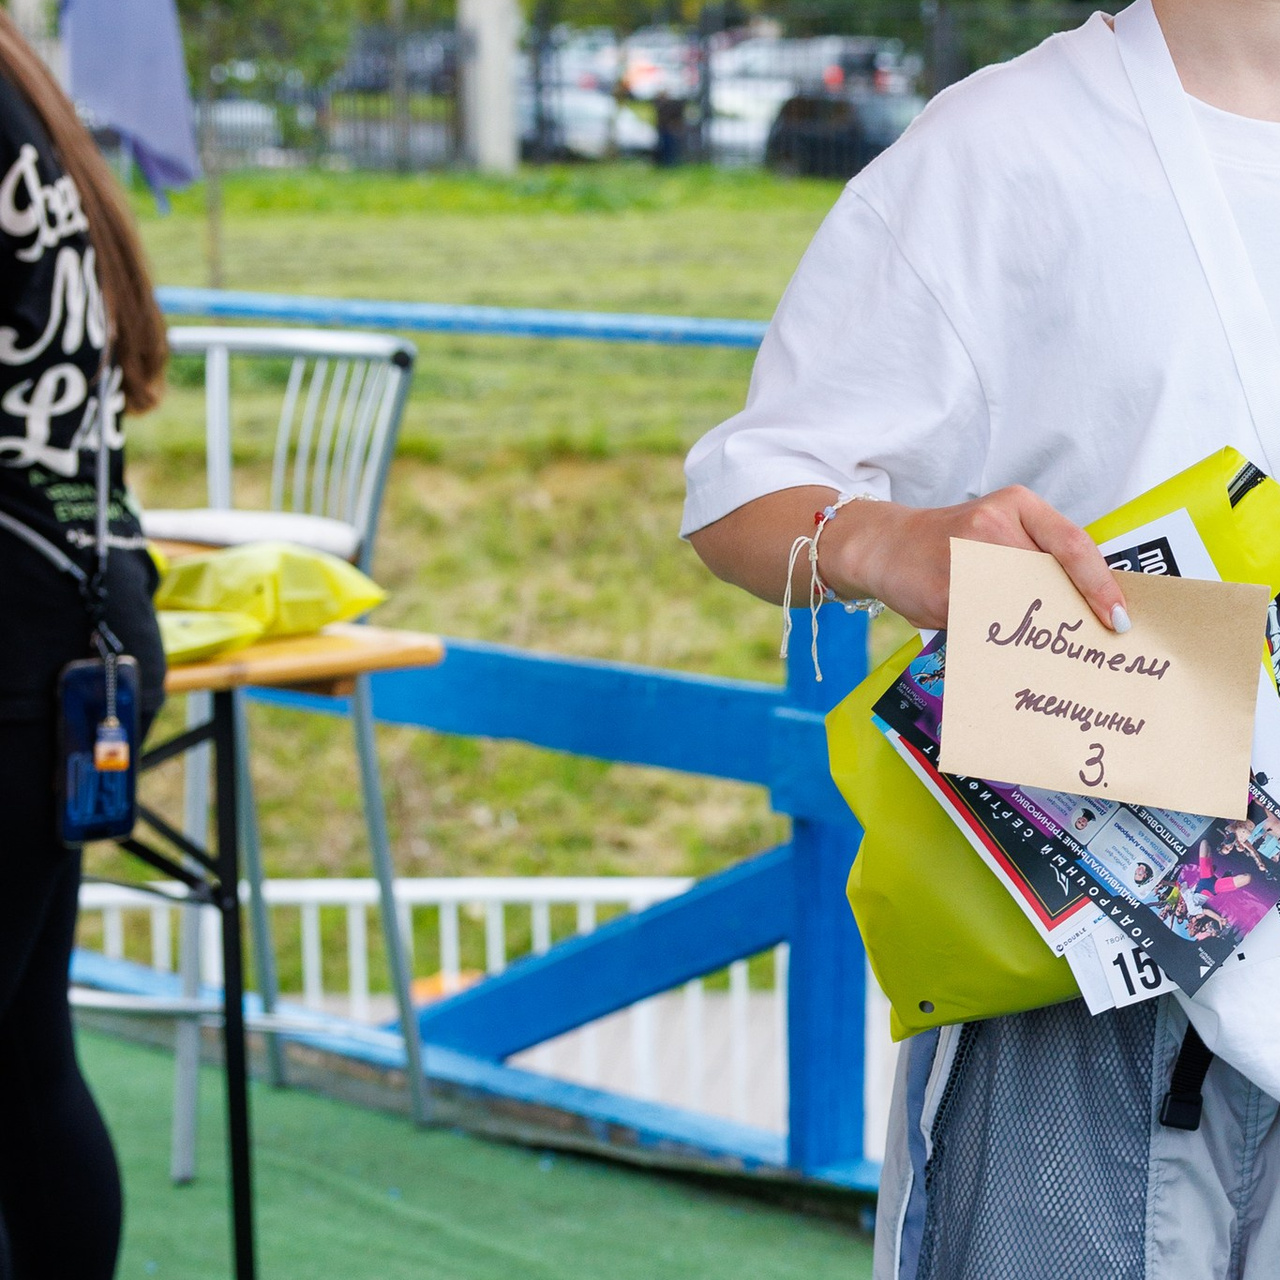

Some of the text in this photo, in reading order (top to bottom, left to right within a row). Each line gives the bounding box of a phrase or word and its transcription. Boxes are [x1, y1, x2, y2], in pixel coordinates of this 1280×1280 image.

[986, 598, 1171, 680] Любители
[1014, 687, 1146, 736] женщины
[1078, 742, 1109, 788] 3.
[1009, 788, 1142, 909] ИНДИВИДУАЛЬНЫЕ ТРЕНИРОВКИ
[1136, 807, 1188, 856] ГРУППОВЫЕ
[1040, 843, 1155, 949] ПОДАРОЧНЫЙ
[1062, 925, 1087, 947] DOUBLE
[1104, 933, 1126, 945] ТВОЙ
[1112, 947, 1176, 997] 15
